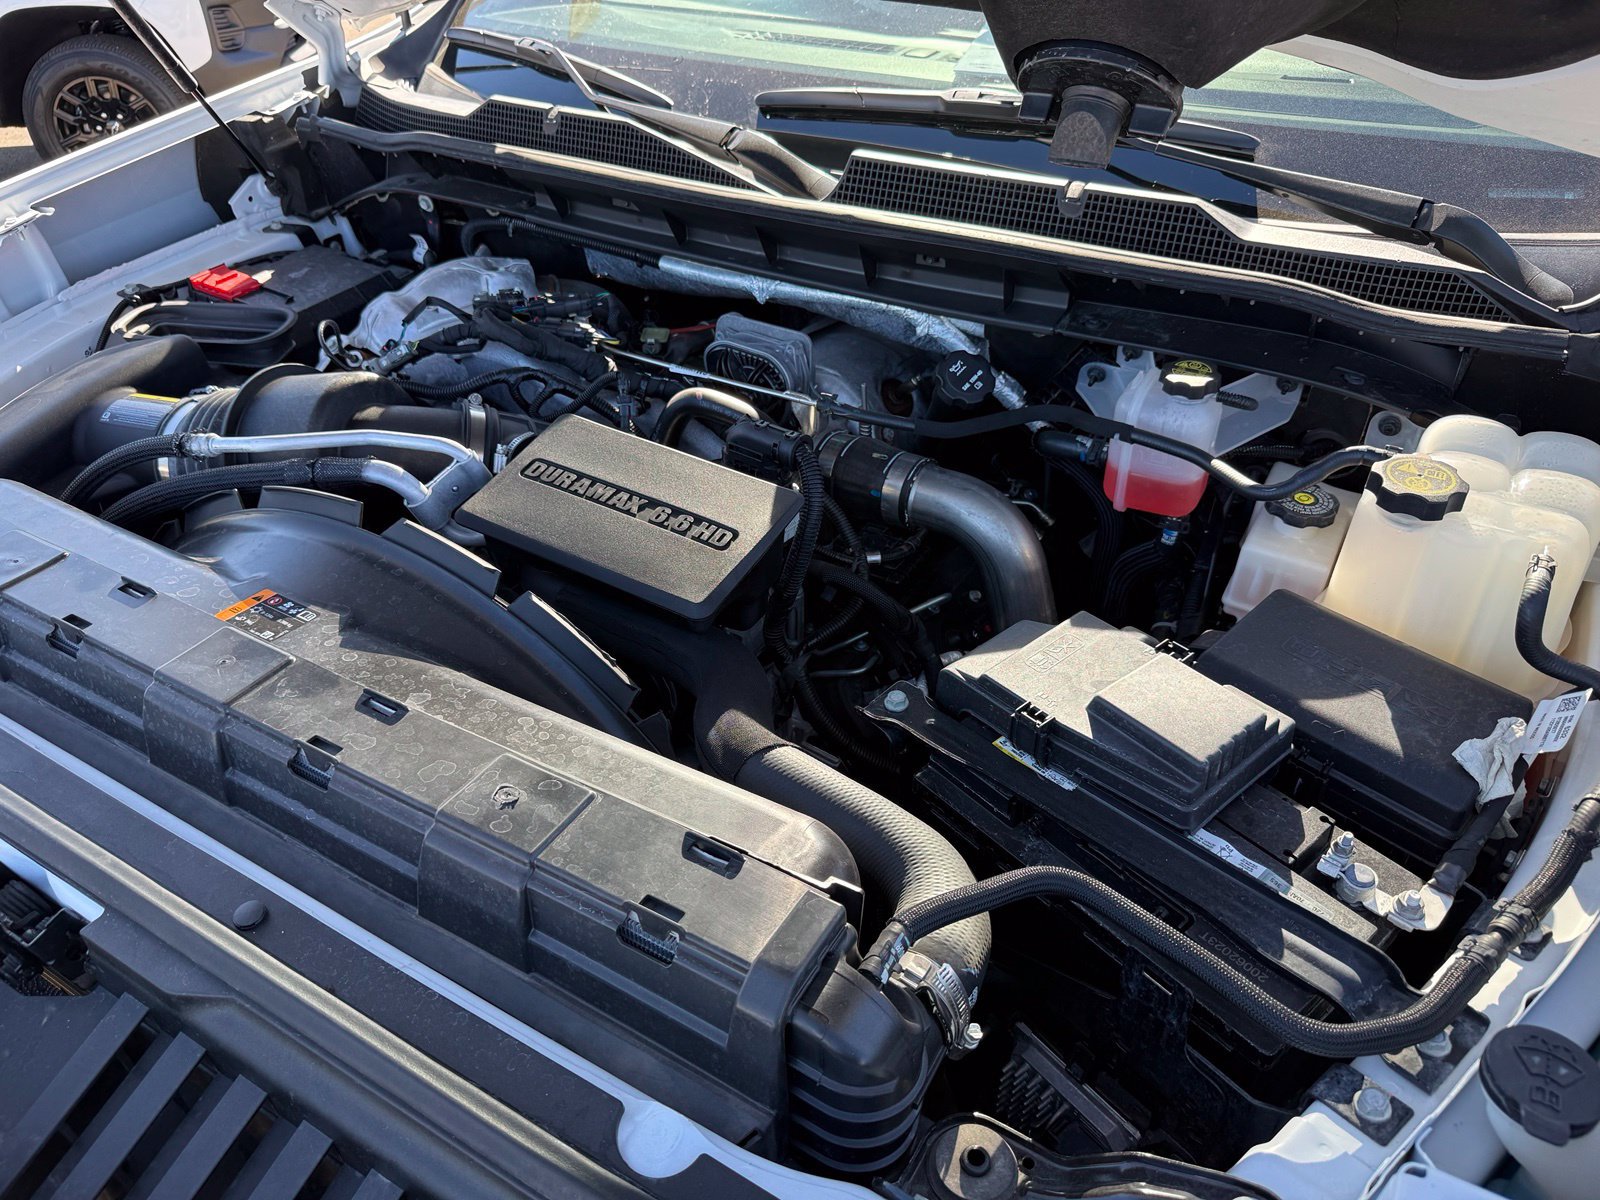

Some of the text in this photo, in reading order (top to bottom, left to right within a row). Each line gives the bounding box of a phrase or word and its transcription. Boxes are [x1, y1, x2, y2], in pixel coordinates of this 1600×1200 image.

[523, 461, 735, 548] DURAMAX 6.6 HD
[1199, 932, 1270, 983] 20062023T
